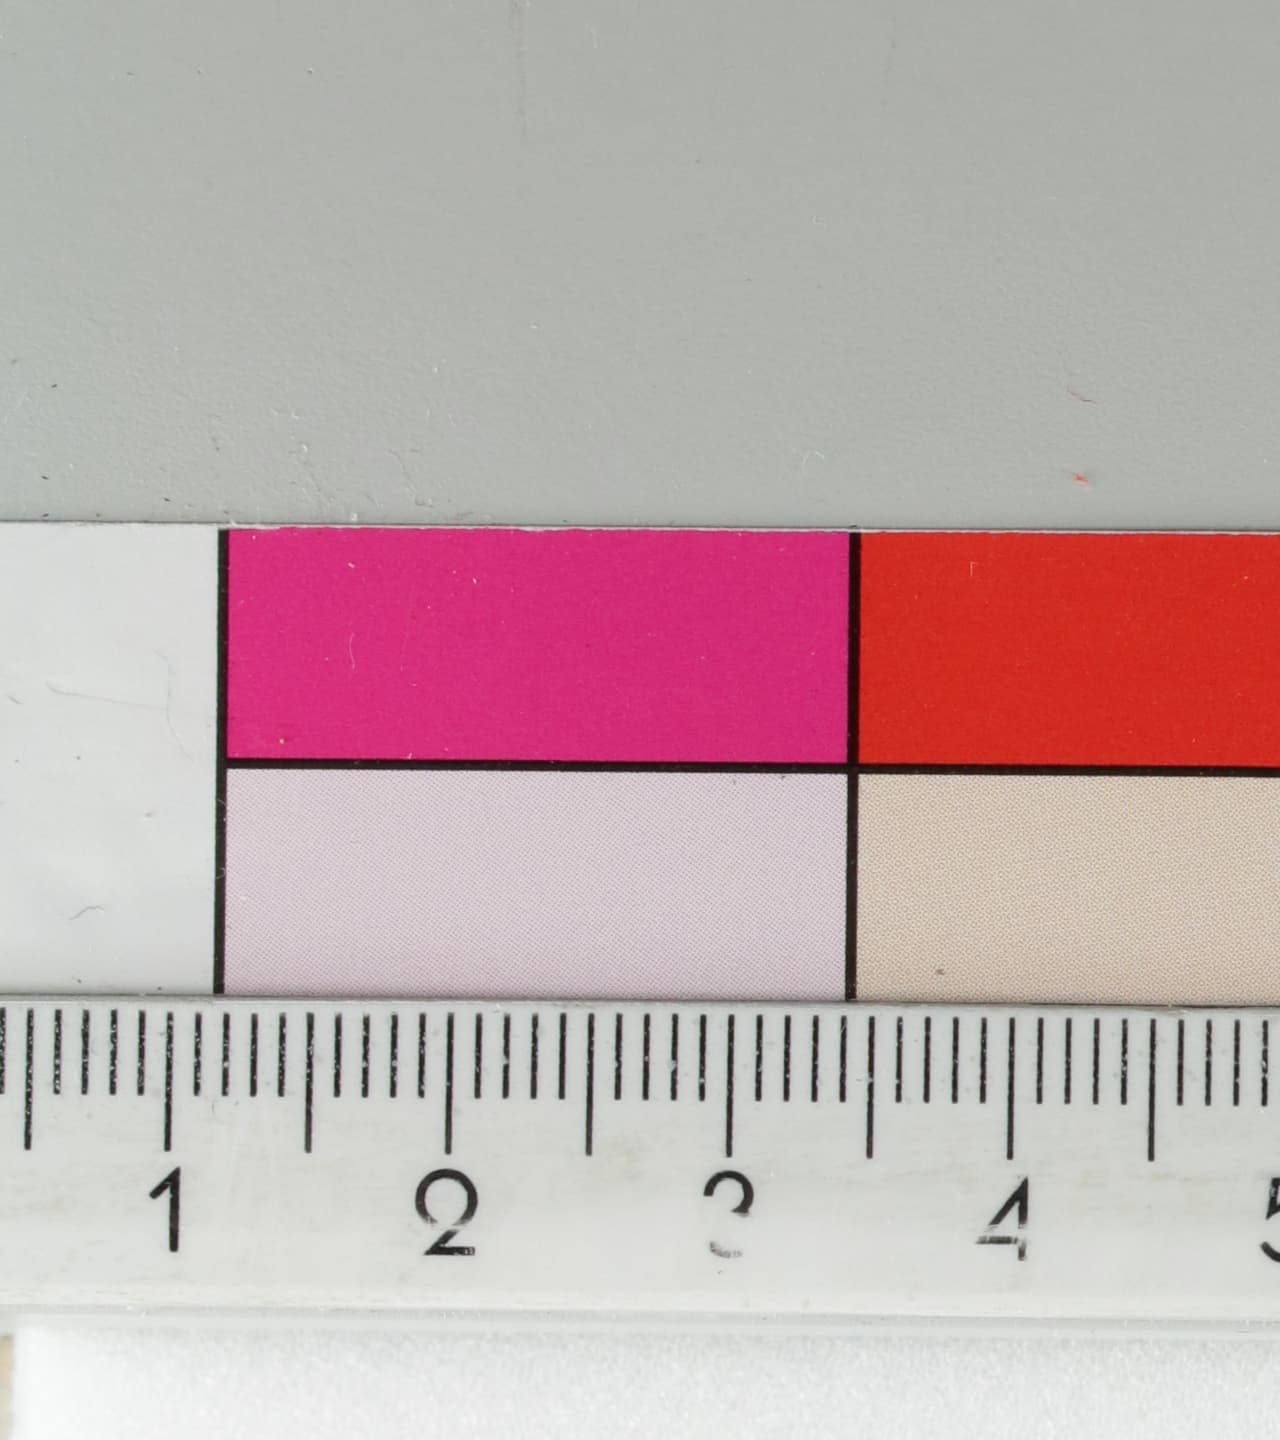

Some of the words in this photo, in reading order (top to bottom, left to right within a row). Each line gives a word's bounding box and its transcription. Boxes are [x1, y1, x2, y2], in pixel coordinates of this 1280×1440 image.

[149, 1166, 181, 1252] 1
[415, 1168, 478, 1256] 2
[703, 1170, 754, 1257] 3
[977, 1176, 1029, 1261] 4
